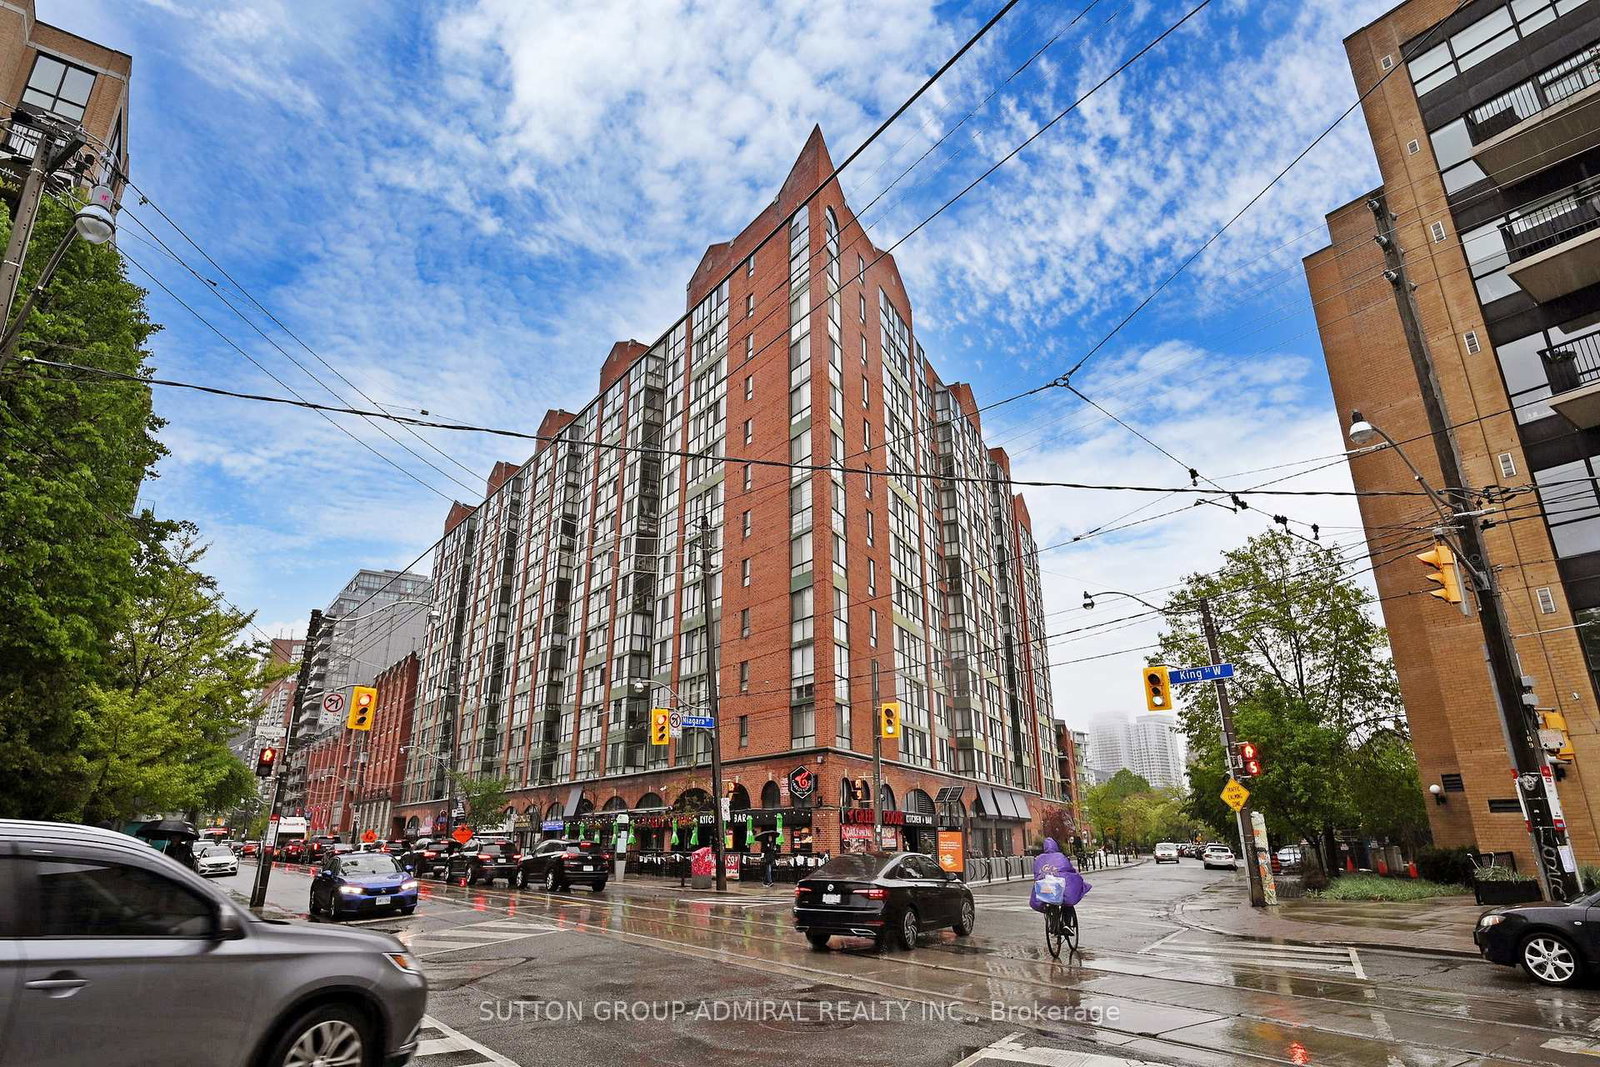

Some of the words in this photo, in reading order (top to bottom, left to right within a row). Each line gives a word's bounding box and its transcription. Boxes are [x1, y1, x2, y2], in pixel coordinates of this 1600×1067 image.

[1179, 670, 1203, 681] King
[1212, 665, 1221, 676] W
[682, 716, 705, 726] Niagara
[700, 814, 715, 824] KITC
